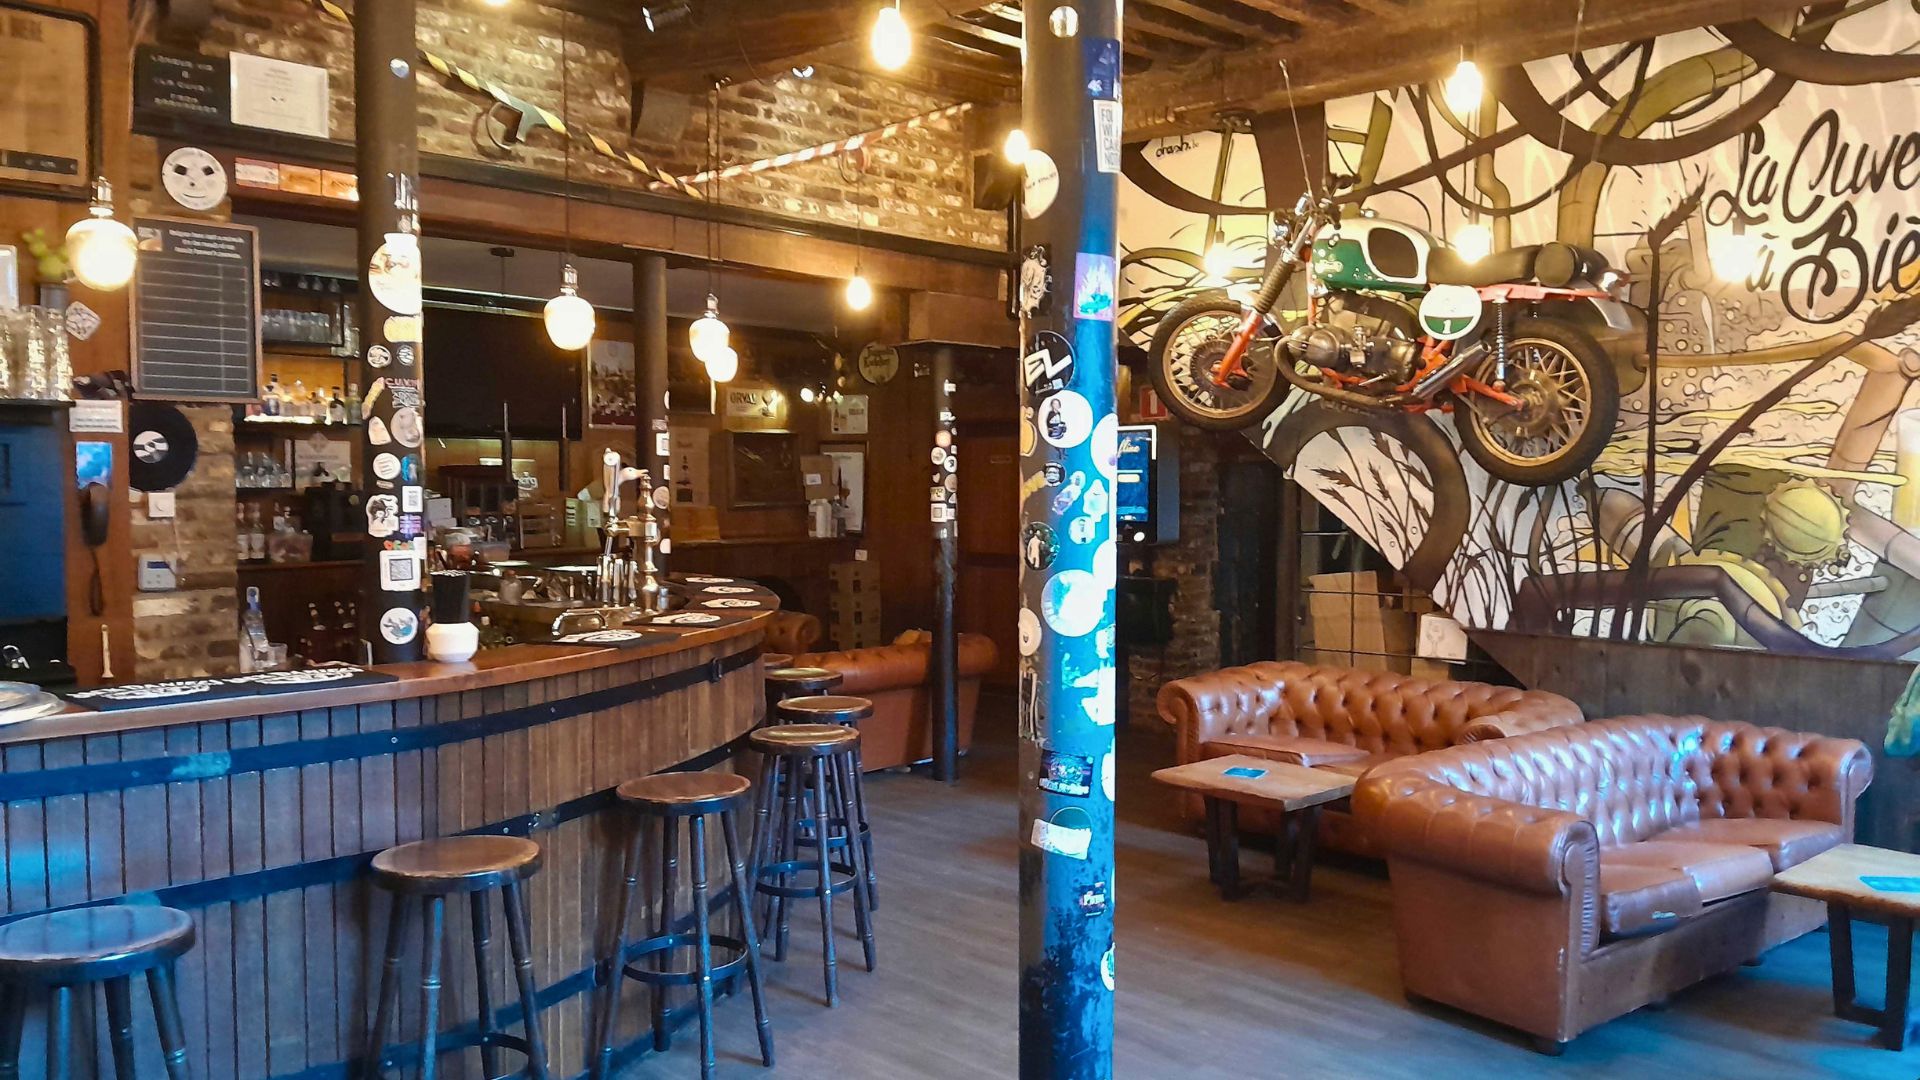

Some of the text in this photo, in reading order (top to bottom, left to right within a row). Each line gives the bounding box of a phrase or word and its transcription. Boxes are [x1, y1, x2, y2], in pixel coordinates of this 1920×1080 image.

[1706, 109, 1920, 226] La Cuve
[1442, 319, 1452, 335] 1
